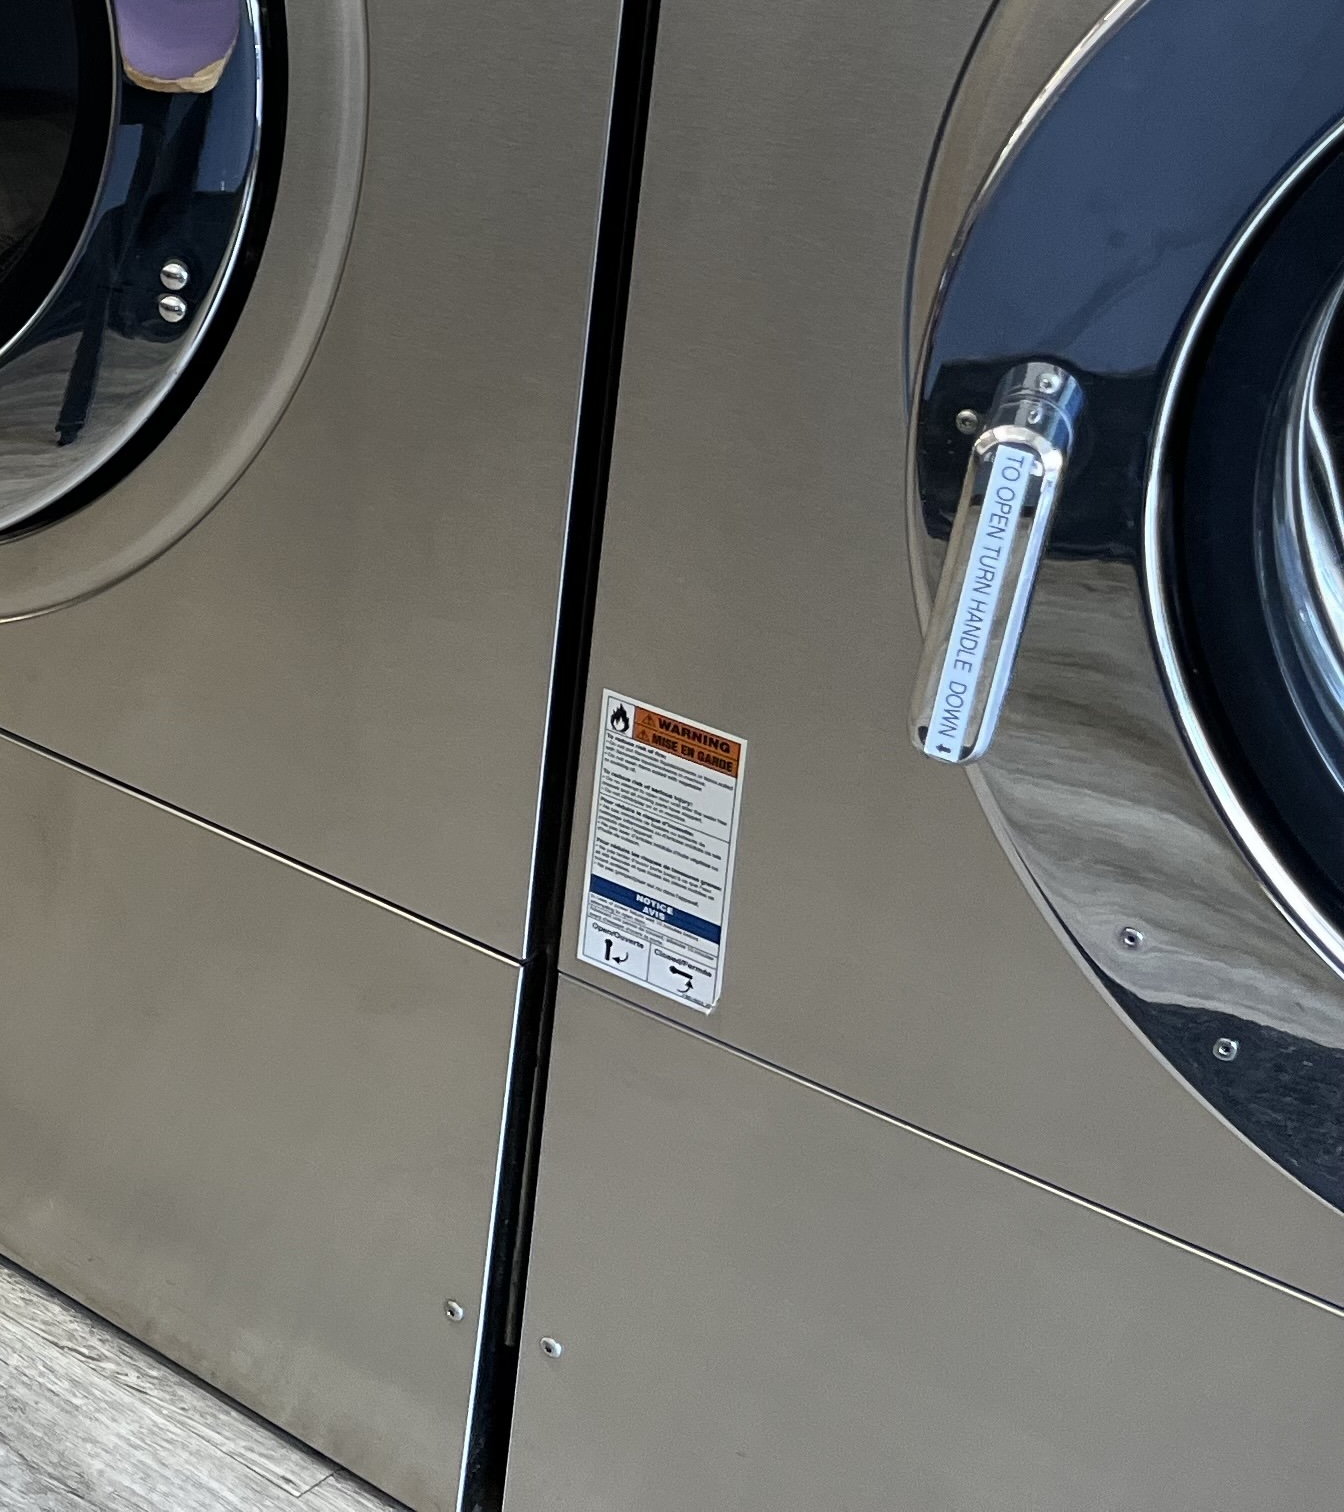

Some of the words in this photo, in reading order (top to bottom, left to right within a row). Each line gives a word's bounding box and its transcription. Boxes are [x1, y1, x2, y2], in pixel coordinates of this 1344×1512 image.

[1002, 456, 1025, 482] TO
[985, 487, 1016, 540] OPEN
[975, 546, 1002, 596] TURN
[953, 598, 988, 673] HANDLE
[938, 680, 967, 739] DOWN
[652, 733, 678, 752] MISE
[681, 744, 695, 759] EN
[697, 751, 733, 773] GARDE
[658, 718, 731, 754] WARNING
[636, 894, 674, 916] NOTICE
[642, 906, 665, 921] AVIS
[592, 922, 644, 949] Open/Ouverte
